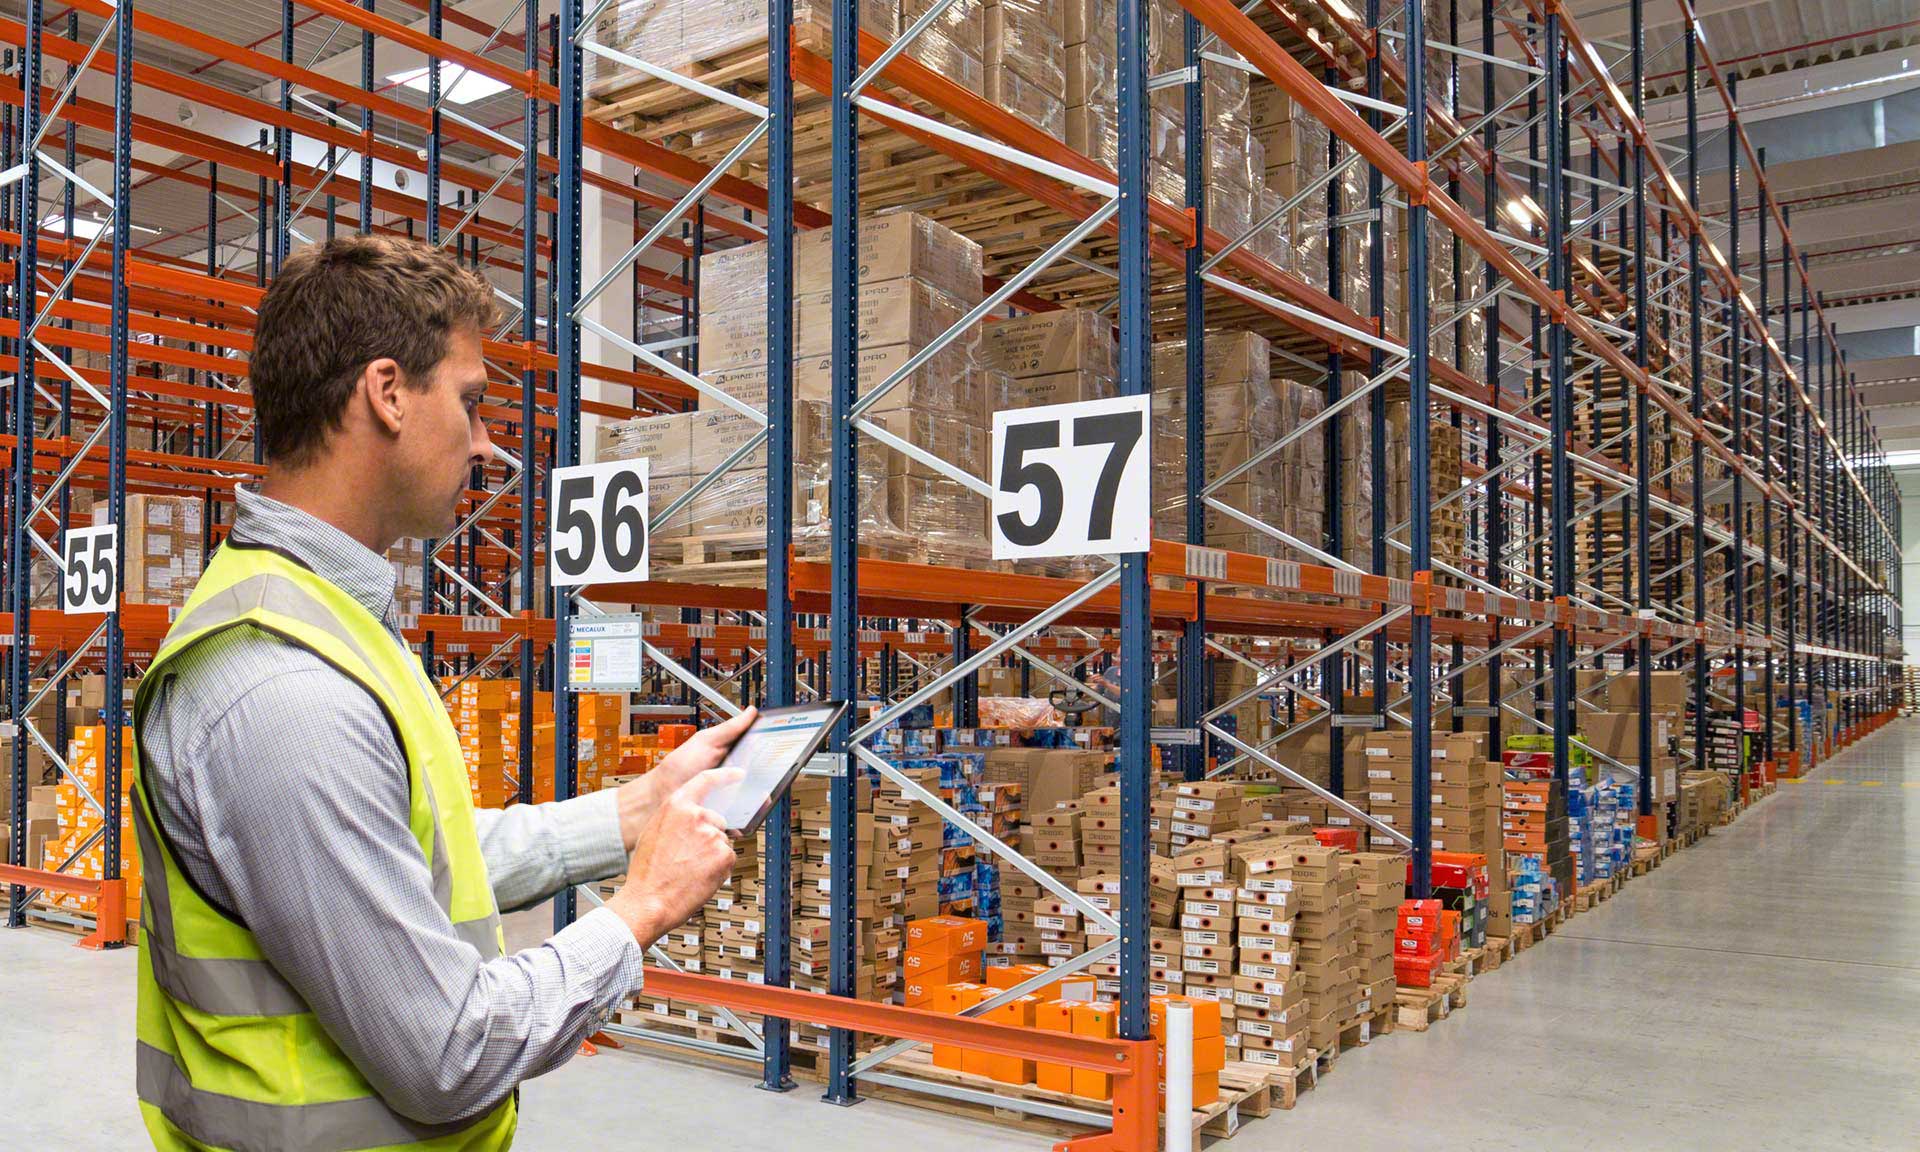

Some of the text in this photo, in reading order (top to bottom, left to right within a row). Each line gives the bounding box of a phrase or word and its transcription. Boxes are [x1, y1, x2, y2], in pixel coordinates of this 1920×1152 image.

[865, 222, 889, 232] PRO
[865, 287, 889, 296] PRO
[863, 353, 887, 362] PRO
[648, 422, 671, 433] PRO
[996, 409, 1143, 547] 57
[553, 470, 645, 576] 56
[66, 533, 114, 607] 55
